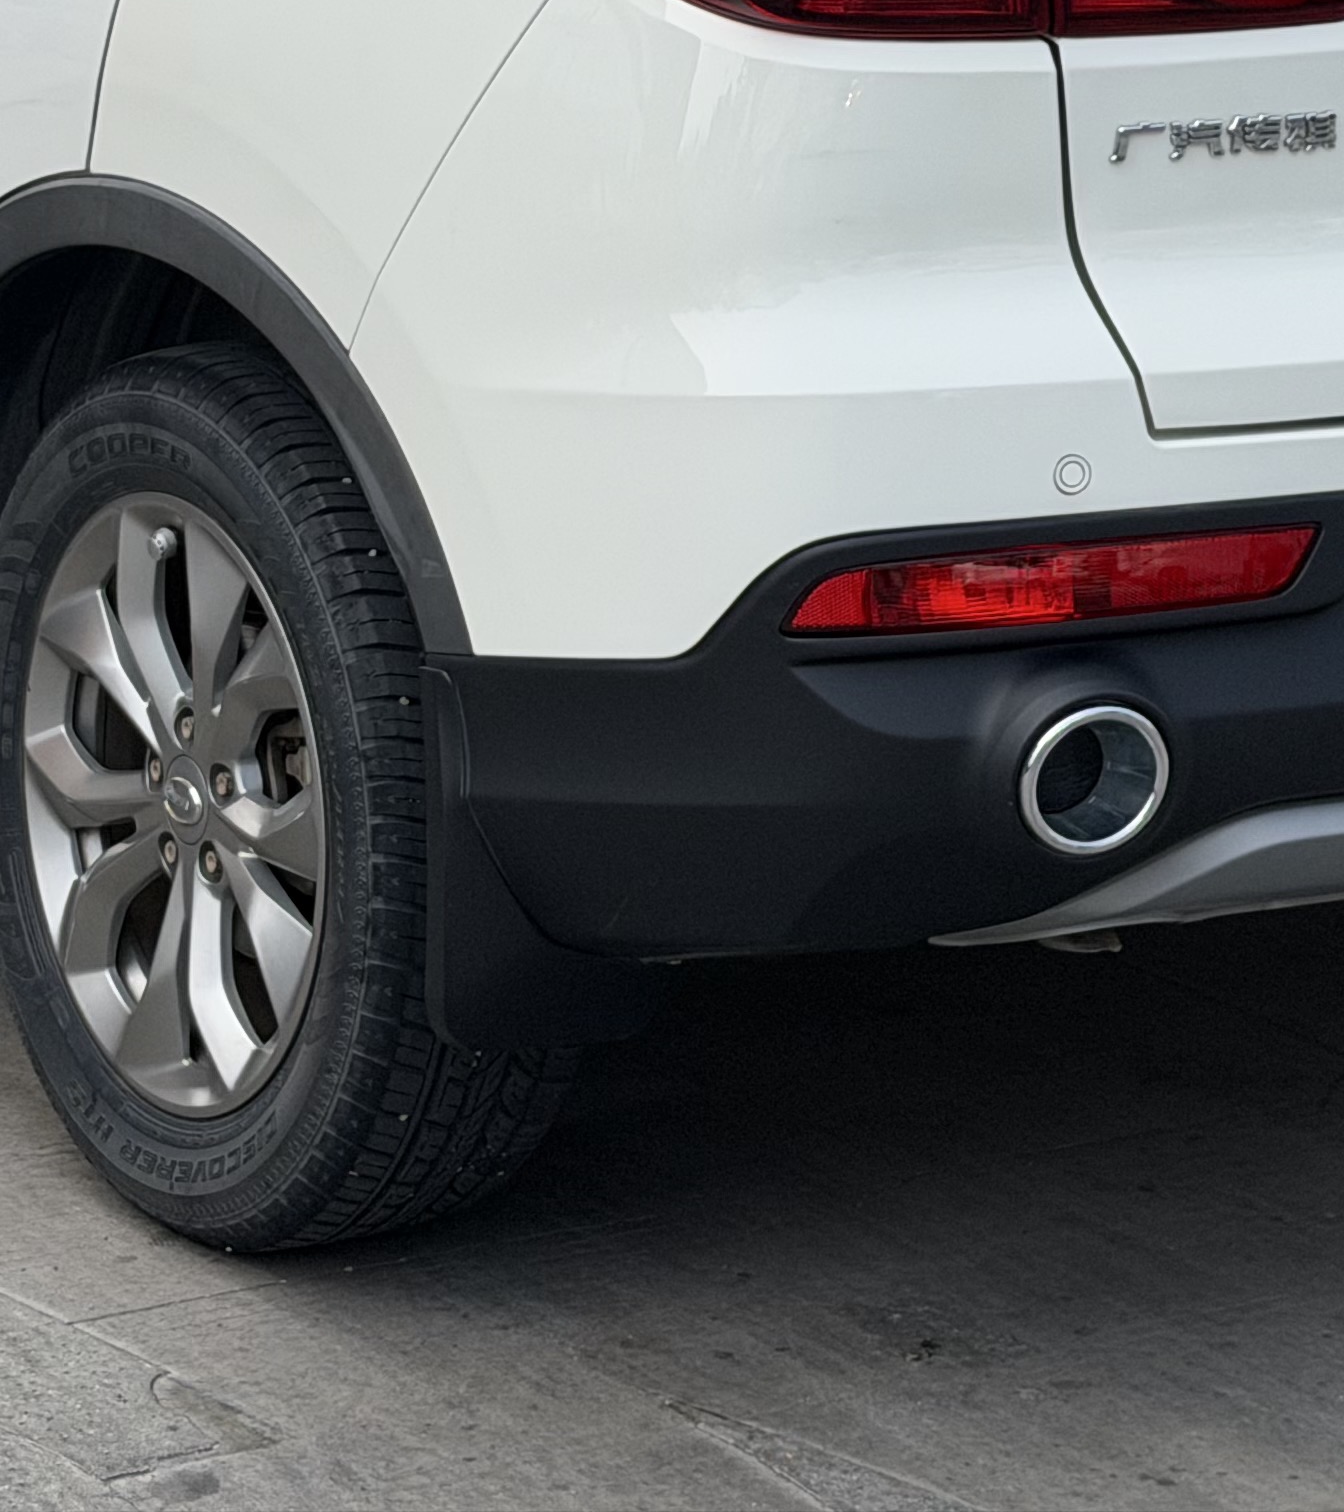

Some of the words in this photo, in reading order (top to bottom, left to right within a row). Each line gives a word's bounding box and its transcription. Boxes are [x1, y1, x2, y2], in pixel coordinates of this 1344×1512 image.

[1108, 109, 1338, 164] 广汽传祺
[67, 431, 192, 478] COOPER
